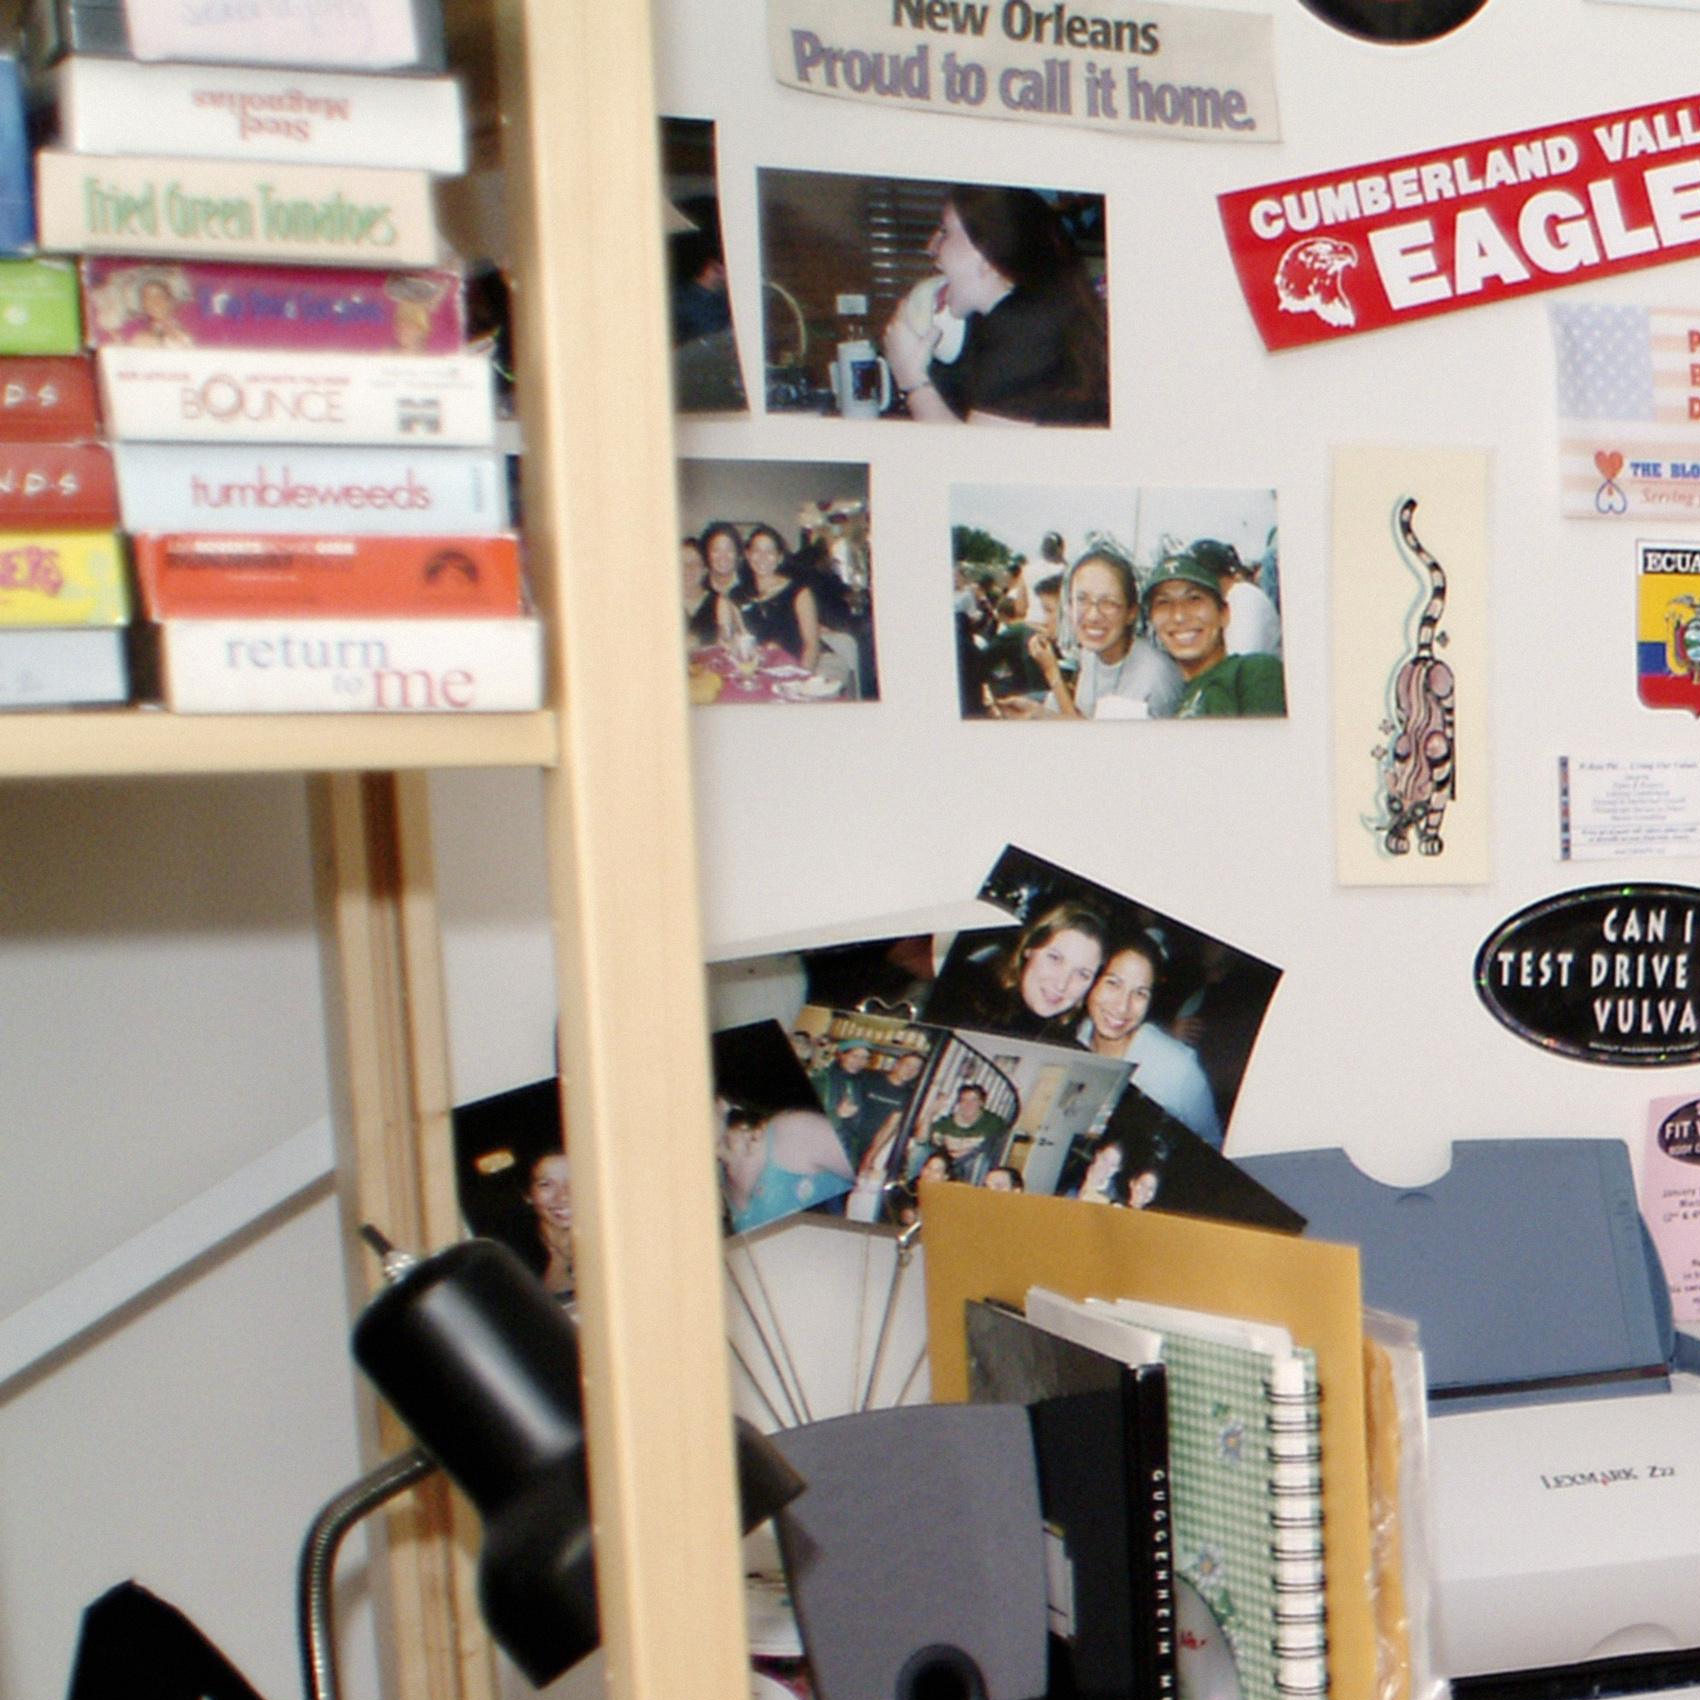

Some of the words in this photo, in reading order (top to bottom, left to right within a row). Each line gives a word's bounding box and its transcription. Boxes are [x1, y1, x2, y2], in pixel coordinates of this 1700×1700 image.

[891, 0, 987, 37] New
[1001, 0, 1159, 56] Orleans
[791, 30, 930, 101] Proud
[942, 53, 988, 106] to
[1000, 57, 1072, 116] call
[1086, 61, 1122, 119] it
[1128, 70, 1257, 132] home.
[240, 114, 312, 143] Steel
[1249, 137, 1579, 240] CUMBERLAND
[81, 176, 157, 236] Fried
[165, 180, 256, 240] Green
[256, 183, 397, 247] Tomatoes
[178, 372, 347, 424] BOUNCE
[189, 464, 433, 510] tumbleweeds
[1630, 461, 1662, 479] THE
[1640, 487, 1695, 509] Serving
[224, 635, 390, 670] return
[372, 666, 476, 708] me
[1603, 907, 1668, 944] CAN
[1683, 908, 1696, 944] I
[1497, 952, 1575, 988] TEST
[1590, 953, 1689, 990] DRIVE
[1593, 998, 1698, 1034] VULVA
[1664, 1121, 1692, 1140] FIT
[1540, 1467, 1639, 1491] LEXMARK
[1151, 1468, 1172, 1655] GUGGENHEIM
